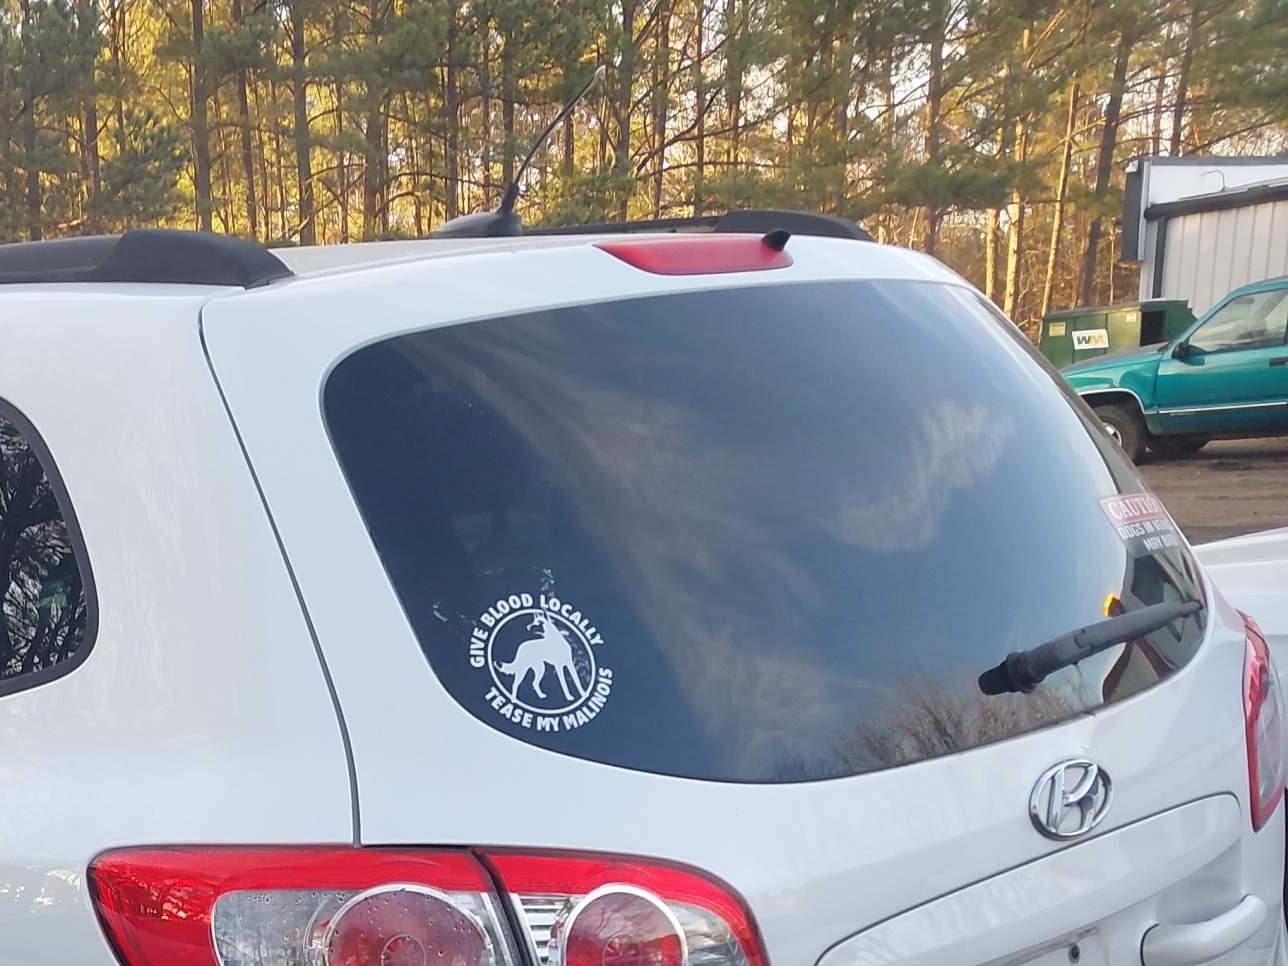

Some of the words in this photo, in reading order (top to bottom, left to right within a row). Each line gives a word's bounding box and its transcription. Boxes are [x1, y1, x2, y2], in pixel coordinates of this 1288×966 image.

[1076, 335, 1104, 345] WM
[469, 627, 489, 668] GIVE
[480, 593, 534, 628] BLOOD
[539, 594, 605, 646] LOCALLY
[484, 686, 534, 728] TEASE
[536, 716, 560, 732] MY
[562, 667, 613, 731] MALINOIS
